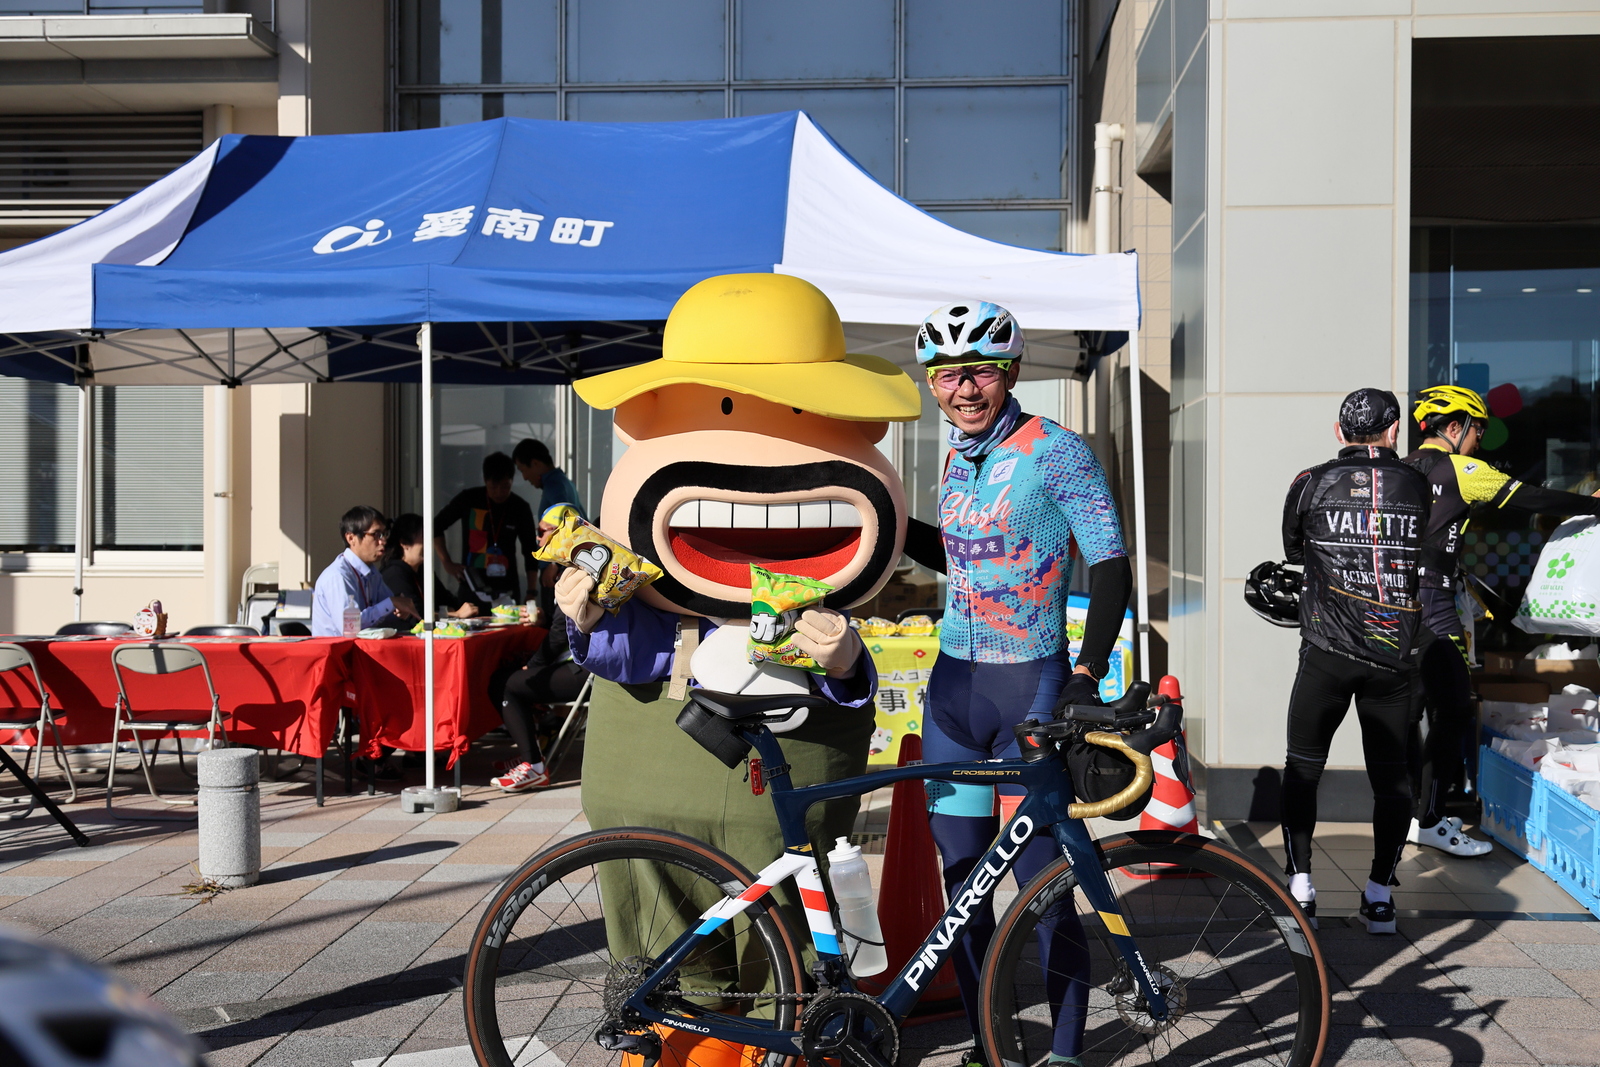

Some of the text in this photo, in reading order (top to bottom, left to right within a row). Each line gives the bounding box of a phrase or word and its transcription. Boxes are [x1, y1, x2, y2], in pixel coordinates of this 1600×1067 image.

[412, 205, 614, 247] 愛南町
[1326, 511, 1417, 538] VALETTE
[587, 834, 631, 844] PIRELLI
[674, 859, 720, 884] metron
[1029, 868, 1078, 916] Visi
[485, 873, 548, 949] Vision
[1135, 950, 1160, 995] PINARELLO
[662, 1017, 710, 1033] PINARELLO
